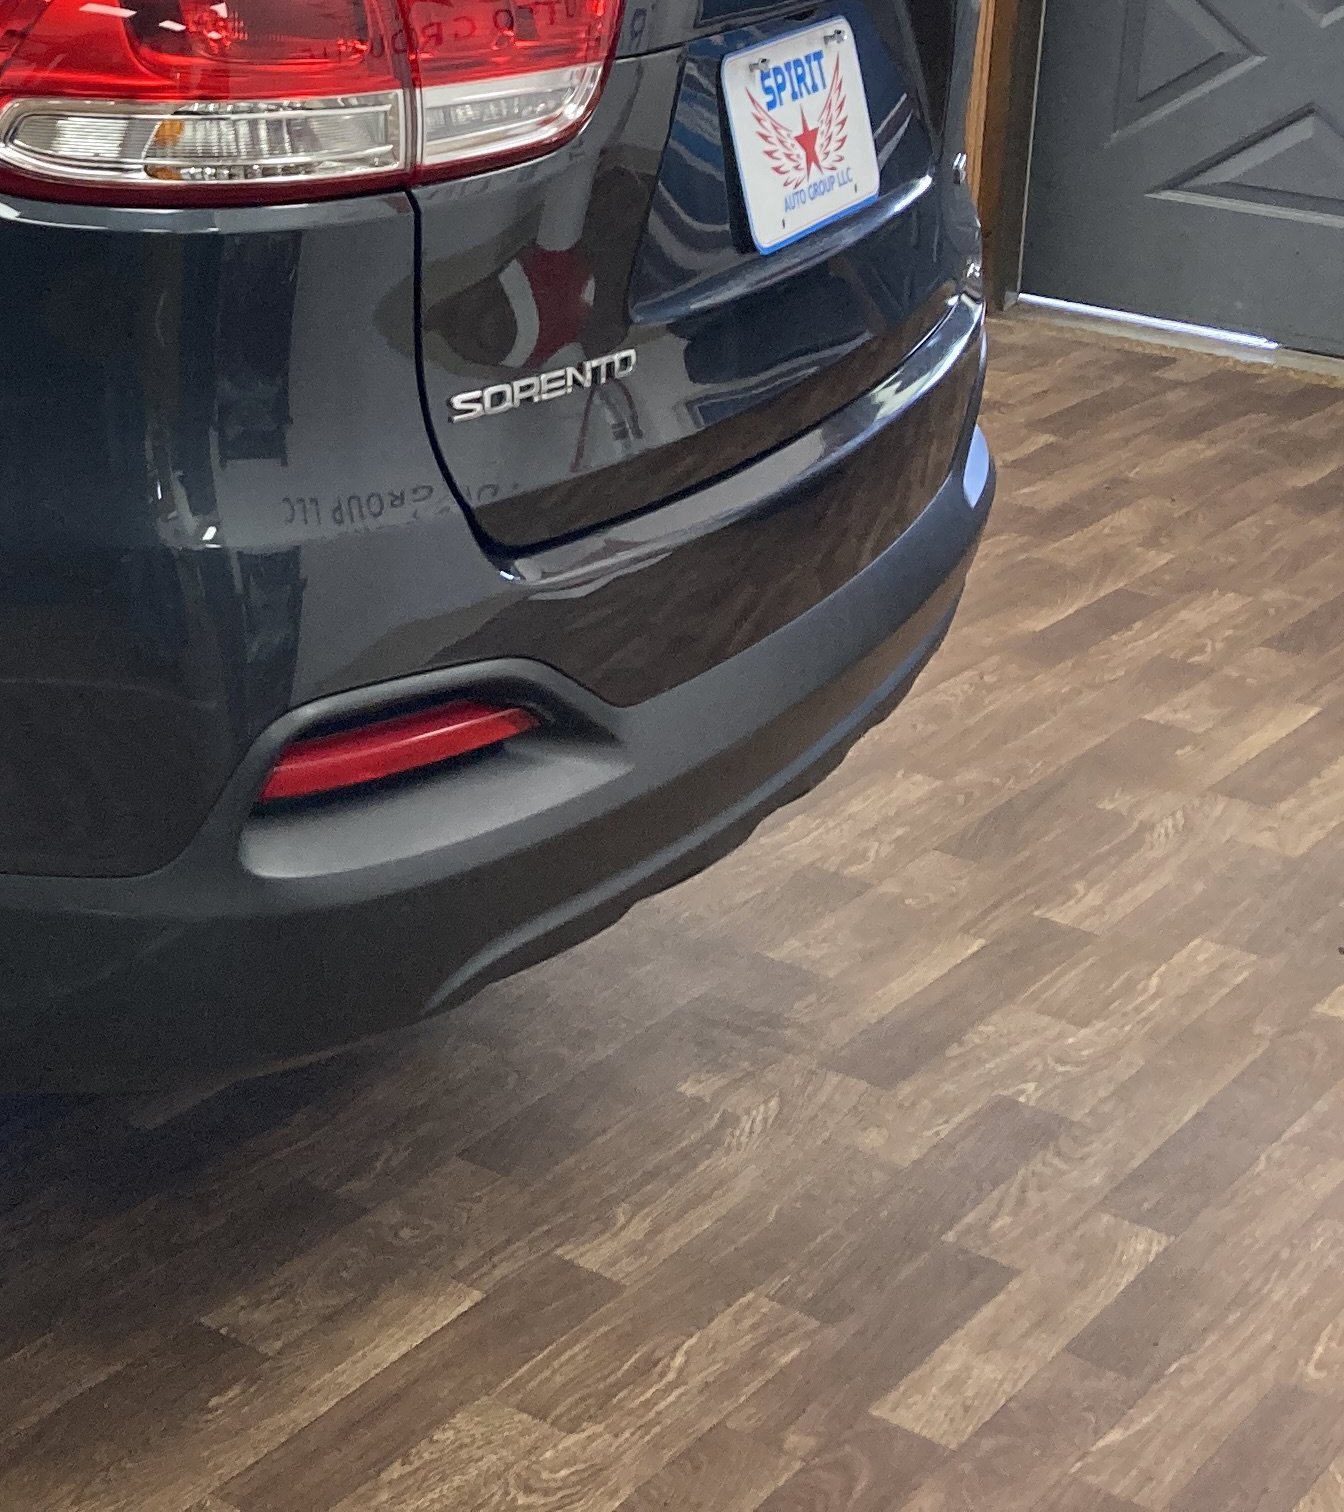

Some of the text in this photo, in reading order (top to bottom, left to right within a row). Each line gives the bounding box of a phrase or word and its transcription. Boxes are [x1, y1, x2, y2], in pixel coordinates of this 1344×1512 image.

[759, 49, 827, 111] SPIRIT
[784, 167, 853, 212] AUTO GROUP LLC
[447, 348, 637, 424] SORENTO
